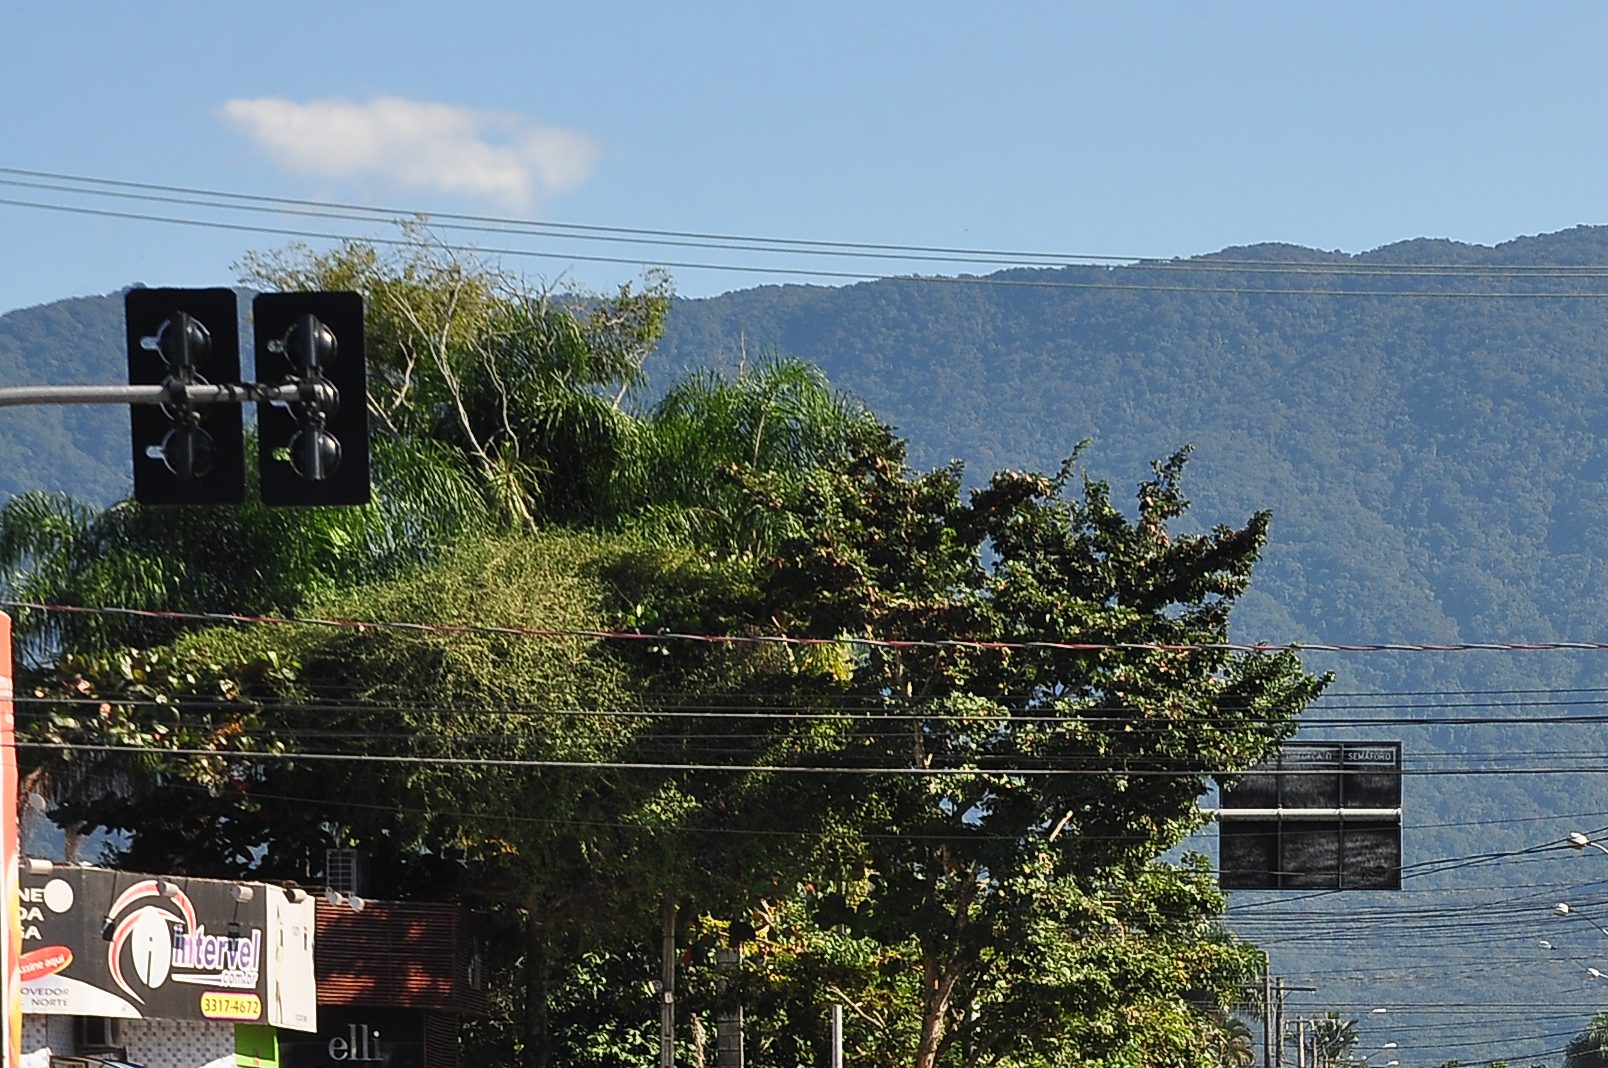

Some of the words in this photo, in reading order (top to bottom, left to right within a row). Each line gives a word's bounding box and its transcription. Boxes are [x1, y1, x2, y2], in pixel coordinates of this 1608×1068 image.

[1348, 750, 1391, 761] SEMÁFORO
[204, 998, 259, 1014] 3317-4672
[328, 1023, 384, 1061] elli
